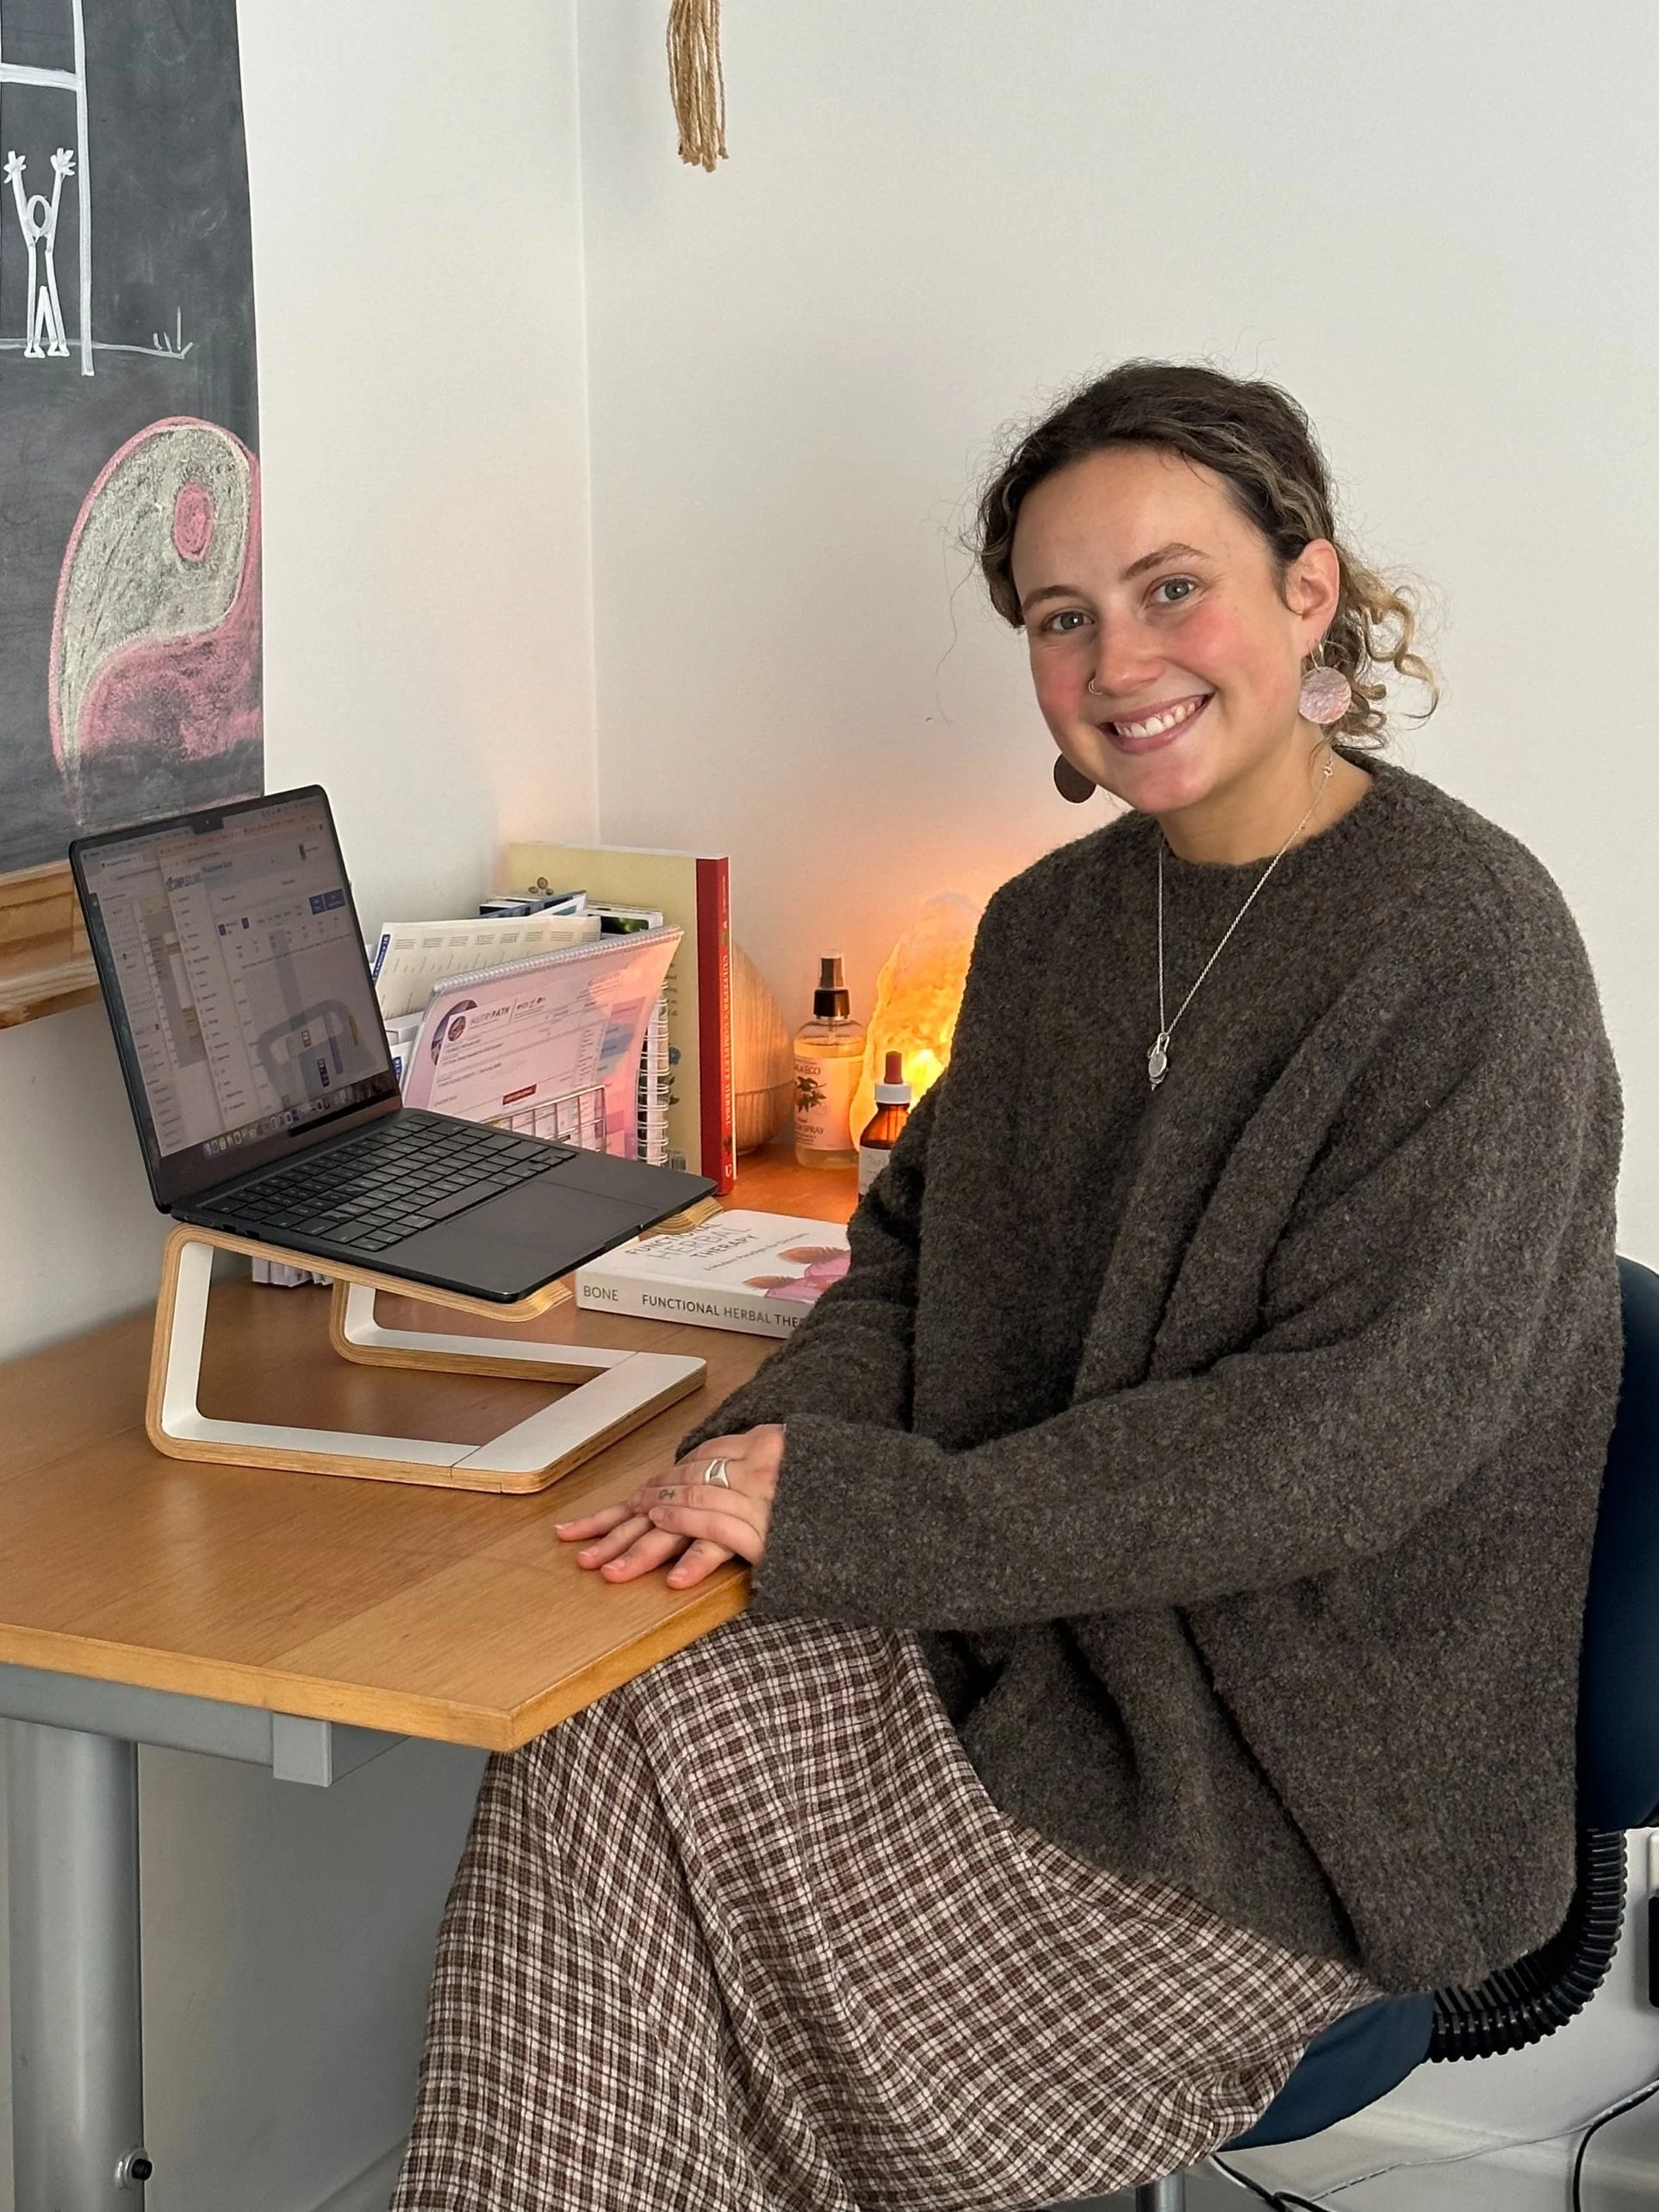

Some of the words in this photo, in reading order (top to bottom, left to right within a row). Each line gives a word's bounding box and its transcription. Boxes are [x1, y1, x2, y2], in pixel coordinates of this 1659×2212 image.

[647, 1227, 752, 1260] HERBAL
[690, 1233, 760, 1258] THERAPY
[582, 1284, 619, 1302] BONE
[642, 1294, 720, 1316] FUNCTIONAL
[723, 1304, 772, 1325] HERBAL
[774, 1314, 799, 1328] THE
